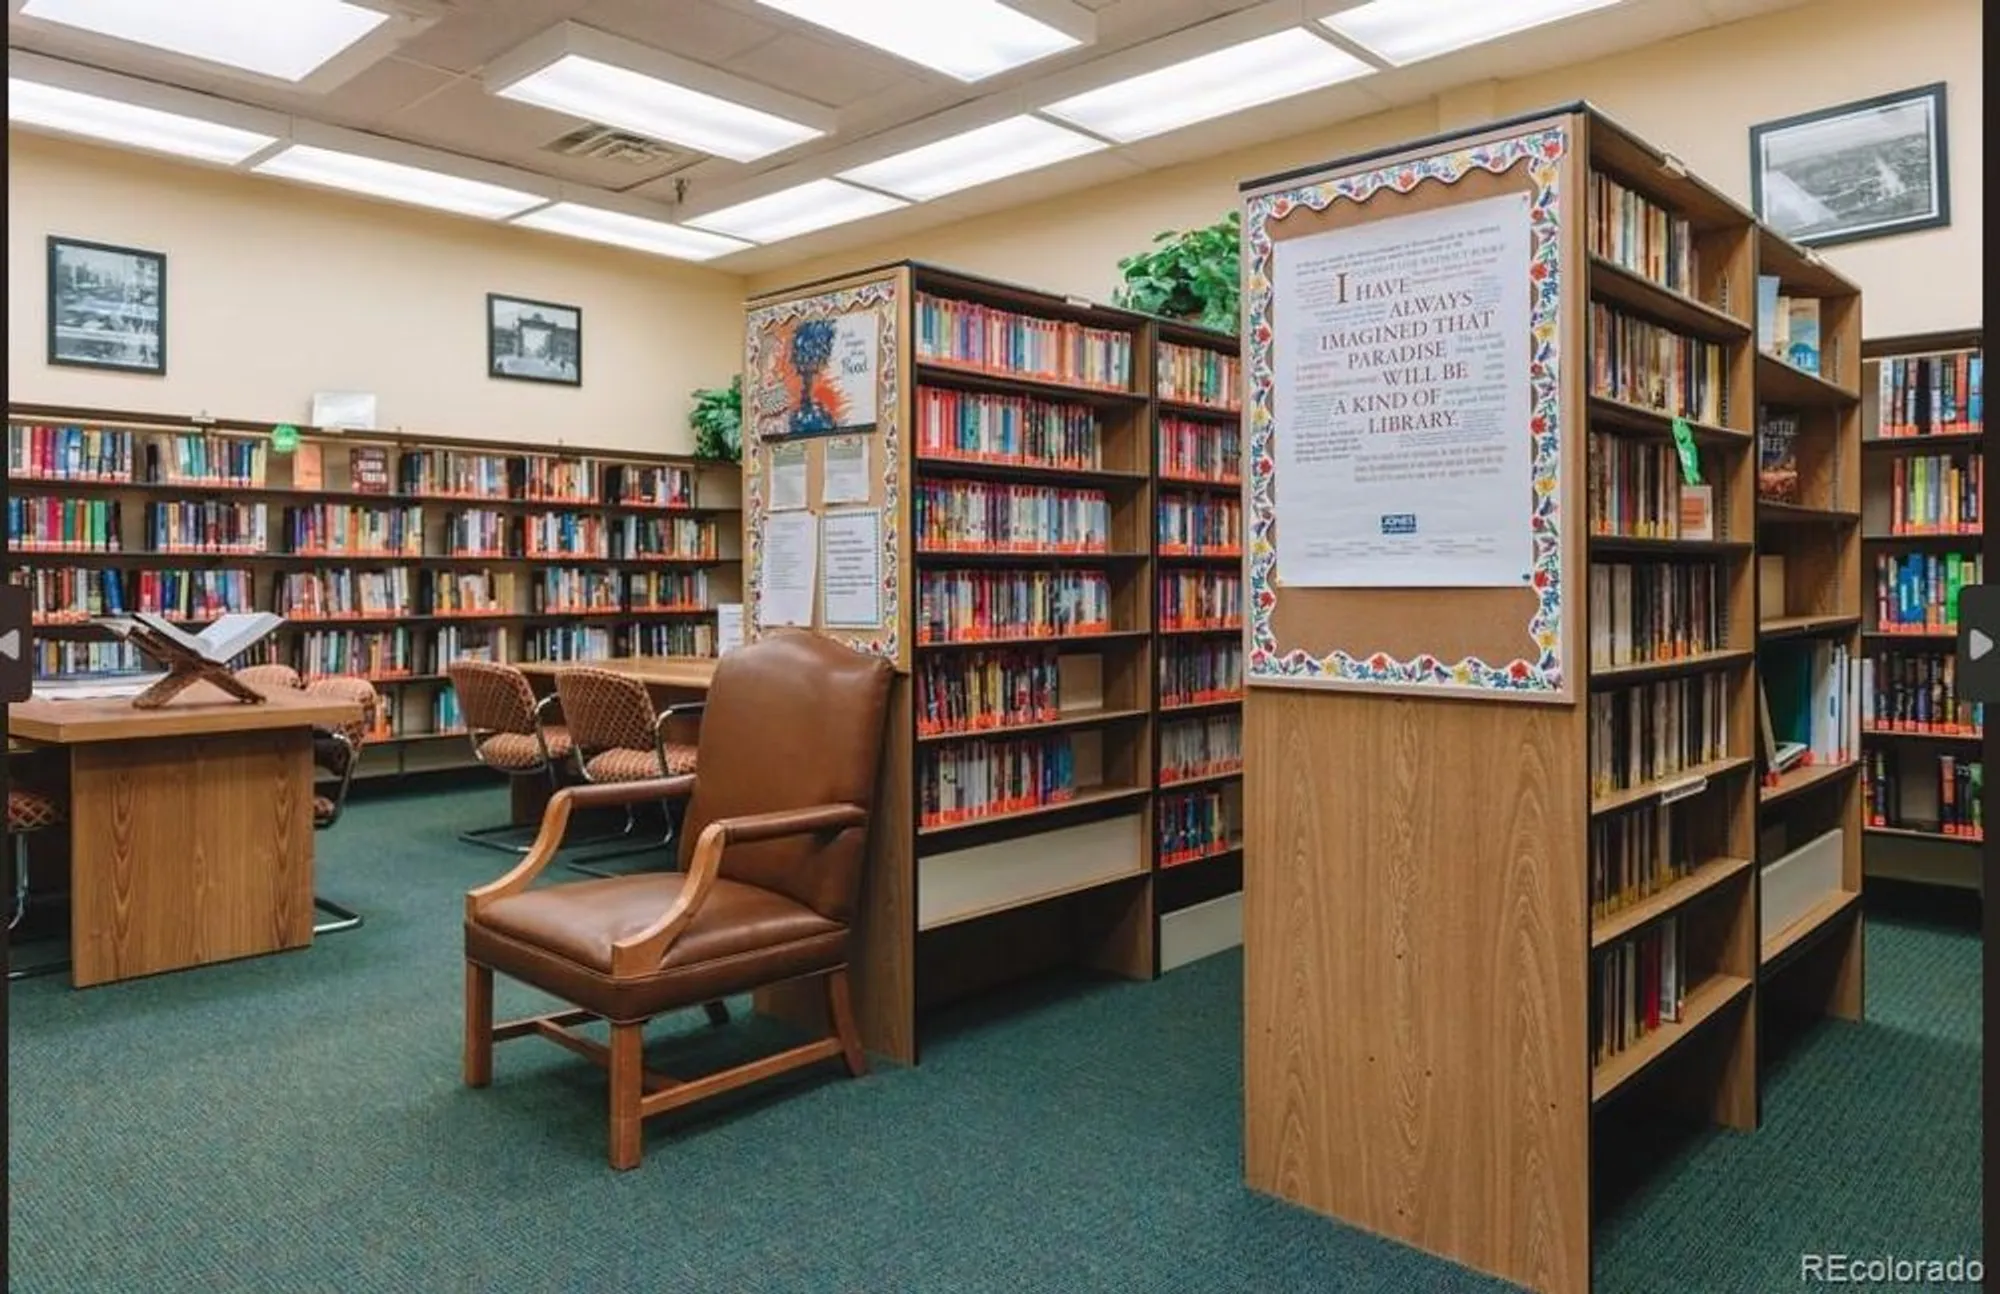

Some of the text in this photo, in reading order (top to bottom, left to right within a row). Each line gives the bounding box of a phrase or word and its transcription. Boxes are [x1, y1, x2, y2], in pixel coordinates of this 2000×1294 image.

[1335, 272, 1349, 304] I
[1356, 278, 1411, 301] HAVE
[1389, 289, 1473, 319] ALWAYS
[1321, 320, 1428, 350] IMAGINED
[1433, 309, 1495, 334] THAT
[1348, 341, 1446, 370] PARADISE
[1382, 364, 1437, 387] WILL
[1443, 361, 1469, 380] BE
[1334, 399, 1347, 416] A
[1351, 391, 1408, 414] KIND
[1413, 387, 1442, 407] OF
[1368, 410, 1460, 434] LIBRARY.
